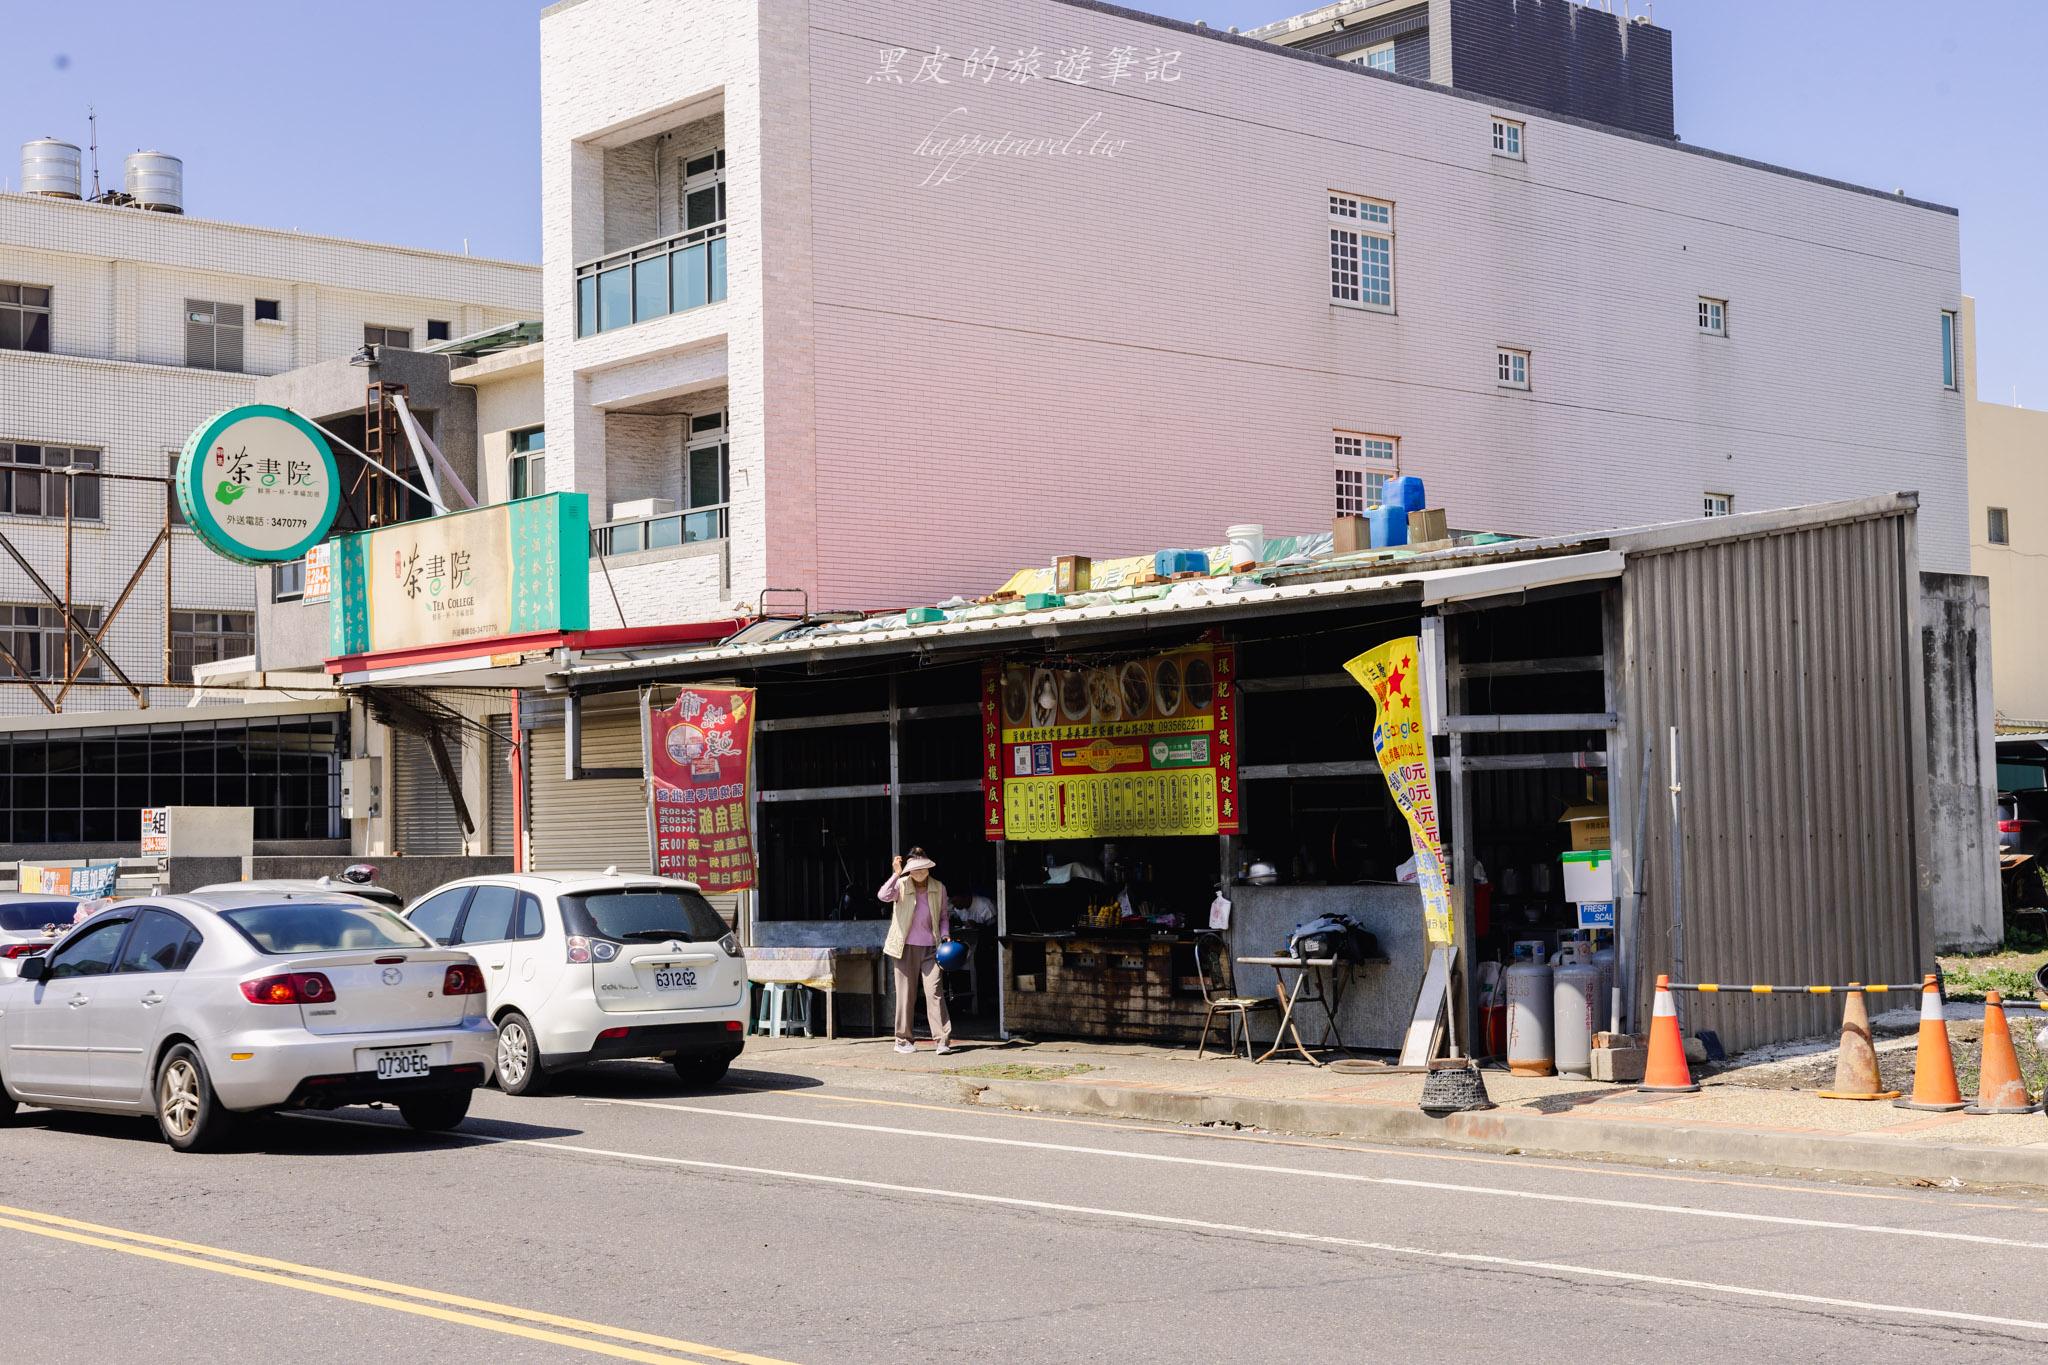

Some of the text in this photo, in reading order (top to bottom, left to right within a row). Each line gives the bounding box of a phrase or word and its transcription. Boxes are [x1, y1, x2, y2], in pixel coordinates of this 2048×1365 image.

[226, 446, 320, 486] 茶書院
[403, 543, 479, 599] 茶書院
[433, 597, 475, 611] TEA COLLEGE
[1158, 719, 1205, 732] 0935662211
[1383, 719, 1419, 740] Google
[152, 811, 166, 834] 租
[1583, 904, 1607, 913] FRESH
[377, 1055, 428, 1076] 0730-EG
